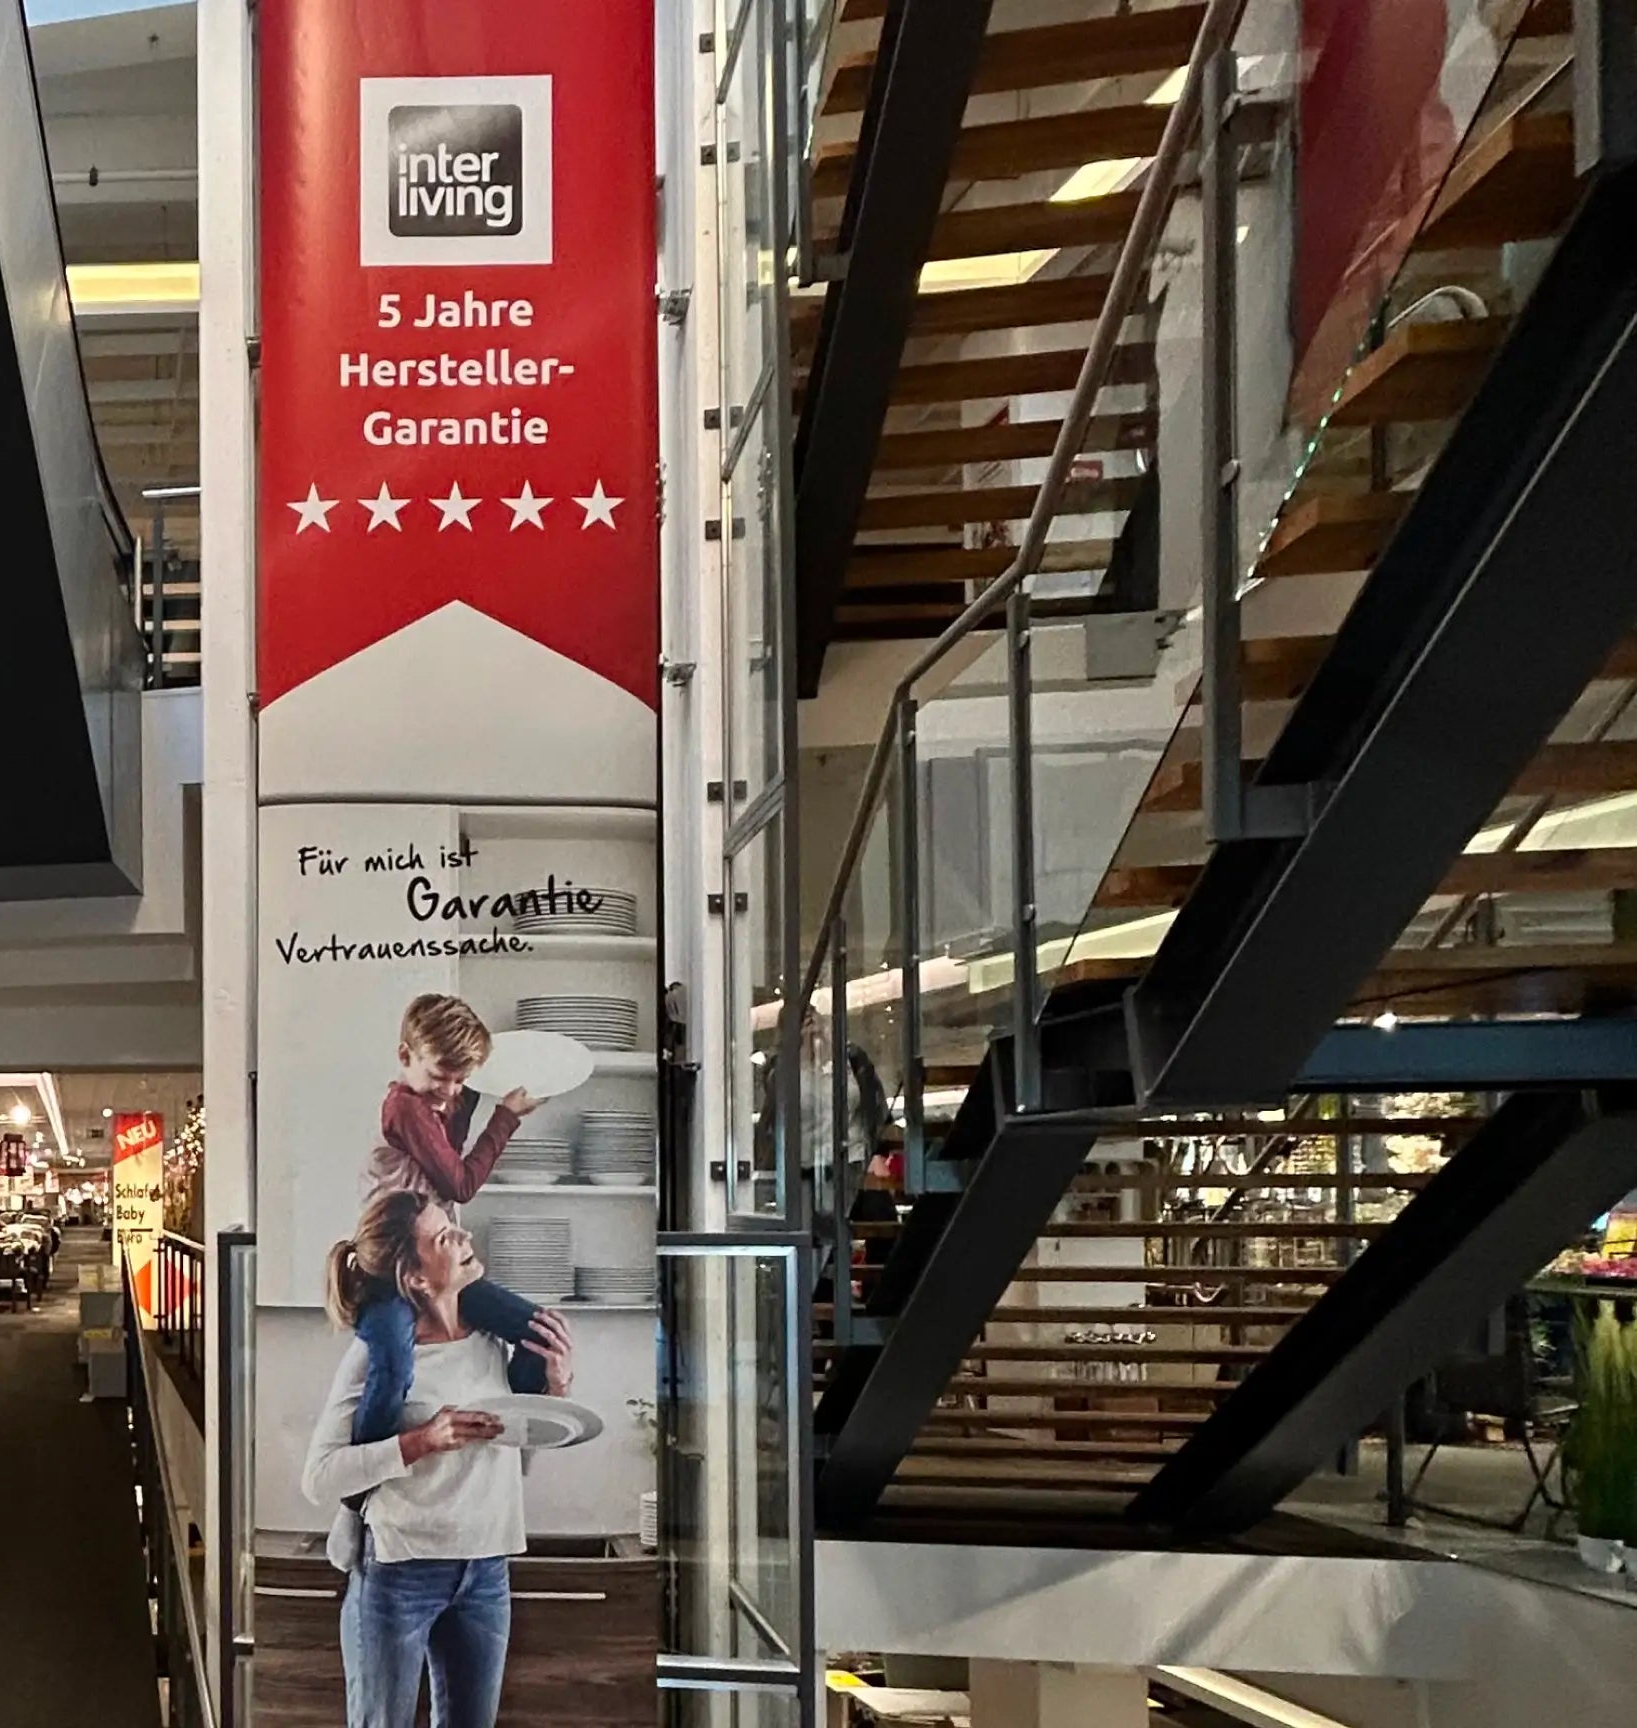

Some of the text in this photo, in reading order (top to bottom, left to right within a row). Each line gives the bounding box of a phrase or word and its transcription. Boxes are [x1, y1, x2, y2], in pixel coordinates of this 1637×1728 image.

[398, 143, 499, 182] inter
[398, 175, 513, 226] living
[378, 290, 534, 328] 5 Jahre
[339, 349, 575, 386] Hersteller-
[363, 407, 549, 445] Garantie
[298, 839, 479, 876] Für mich ist
[406, 874, 604, 921] Garantie
[275, 928, 534, 964] Vertrauenssache.
[116, 1120, 157, 1150] NEU
[116, 1204, 145, 1224] Baby
